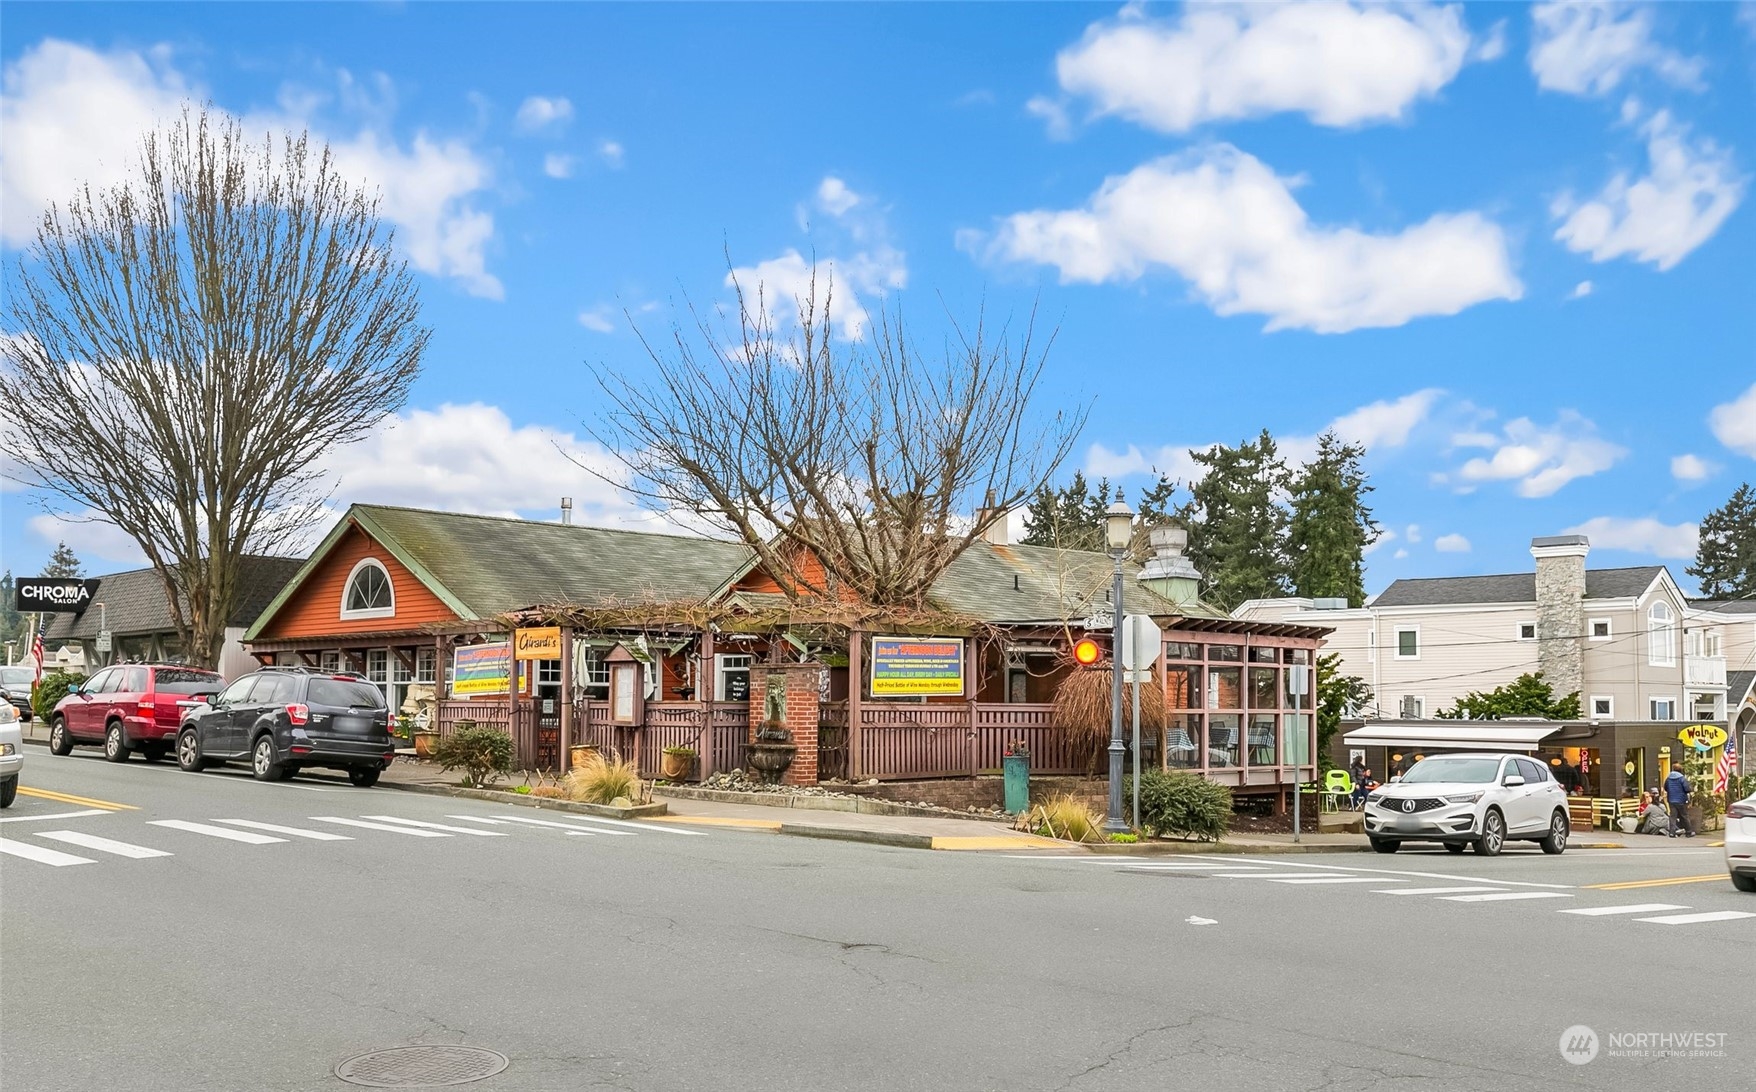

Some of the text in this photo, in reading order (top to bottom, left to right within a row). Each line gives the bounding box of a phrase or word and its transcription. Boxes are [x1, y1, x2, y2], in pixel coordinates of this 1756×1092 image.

[21, 585, 90, 601] CHROMA
[519, 632, 557, 651] Girardi's
[1687, 724, 1719, 740] Walnut
[1581, 750, 1589, 773] OPEN
